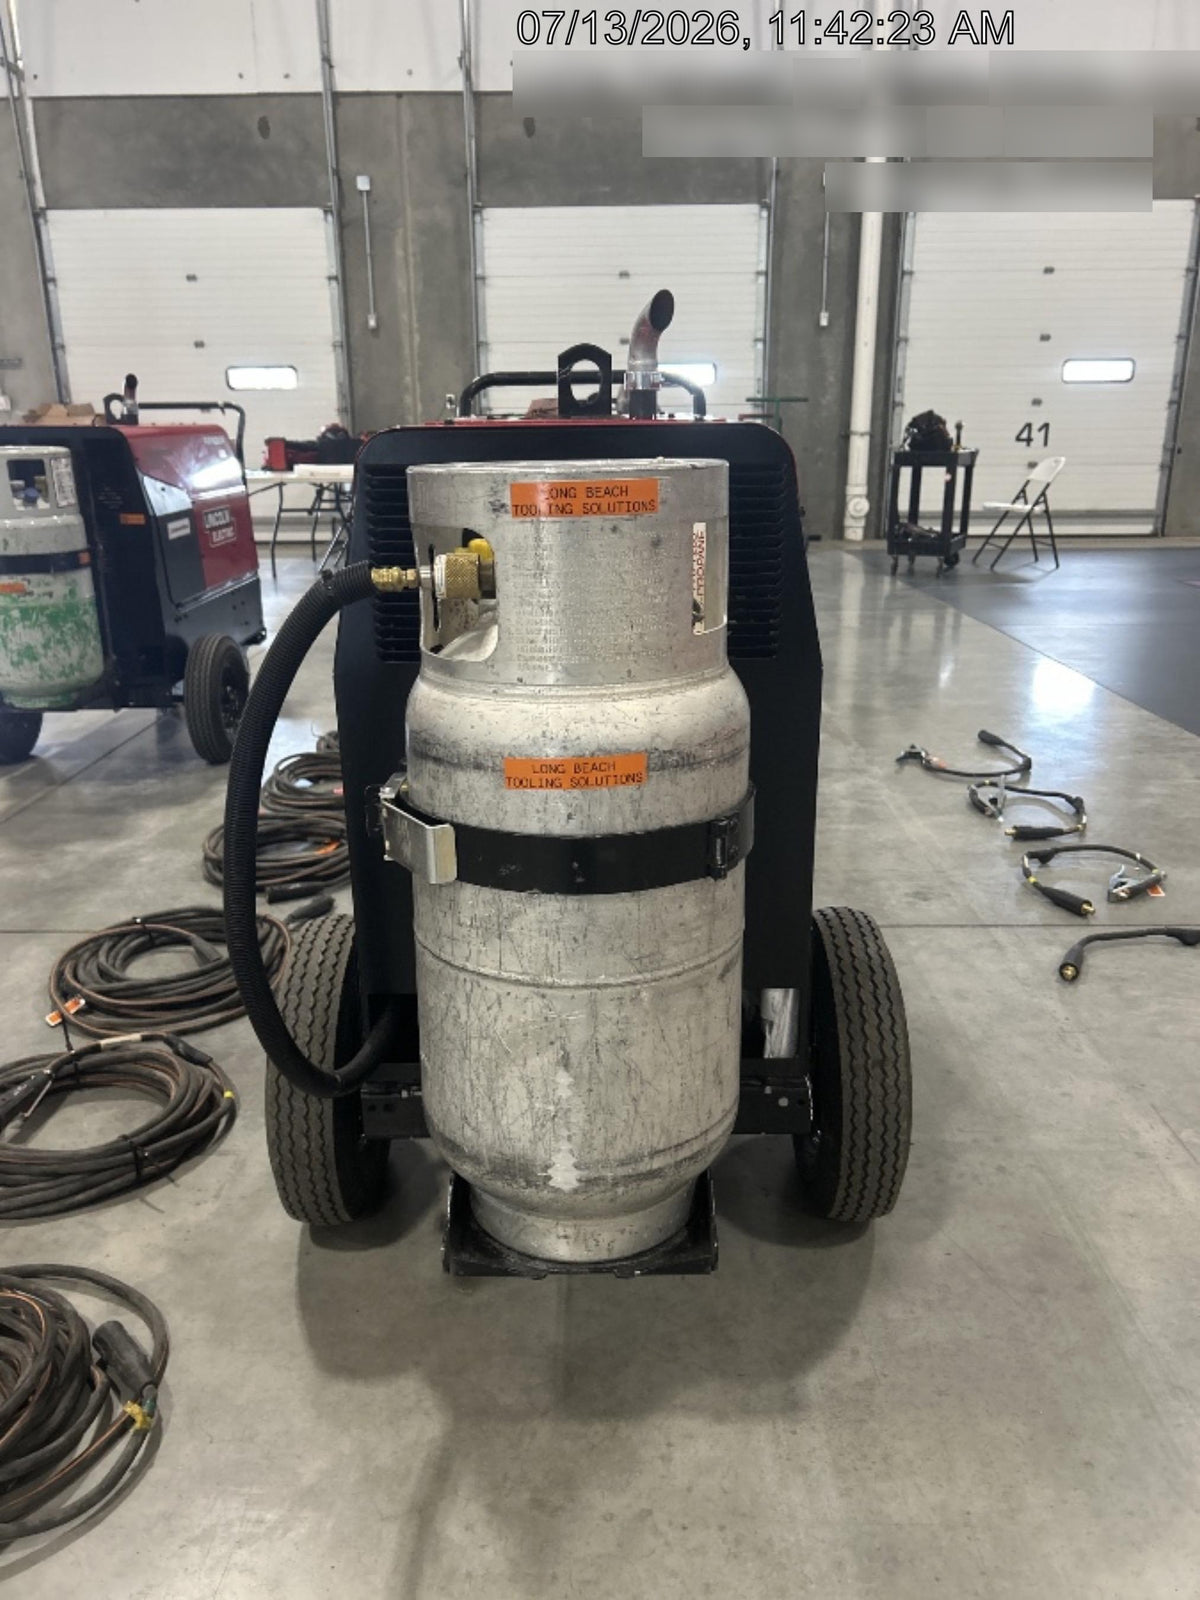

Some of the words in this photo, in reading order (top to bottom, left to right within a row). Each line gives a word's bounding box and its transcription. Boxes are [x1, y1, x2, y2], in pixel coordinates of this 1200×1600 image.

[1014, 421, 1050, 448] 41
[586, 485, 629, 499] BEACH
[512, 503, 573, 517] TOOING
[582, 499, 656, 515] SOLUTIONS
[532, 763, 566, 775] LONG
[573, 761, 616, 774] BEACH
[505, 776, 562, 789] TOOLING
[570, 772, 643, 788] SOLUTIONS
